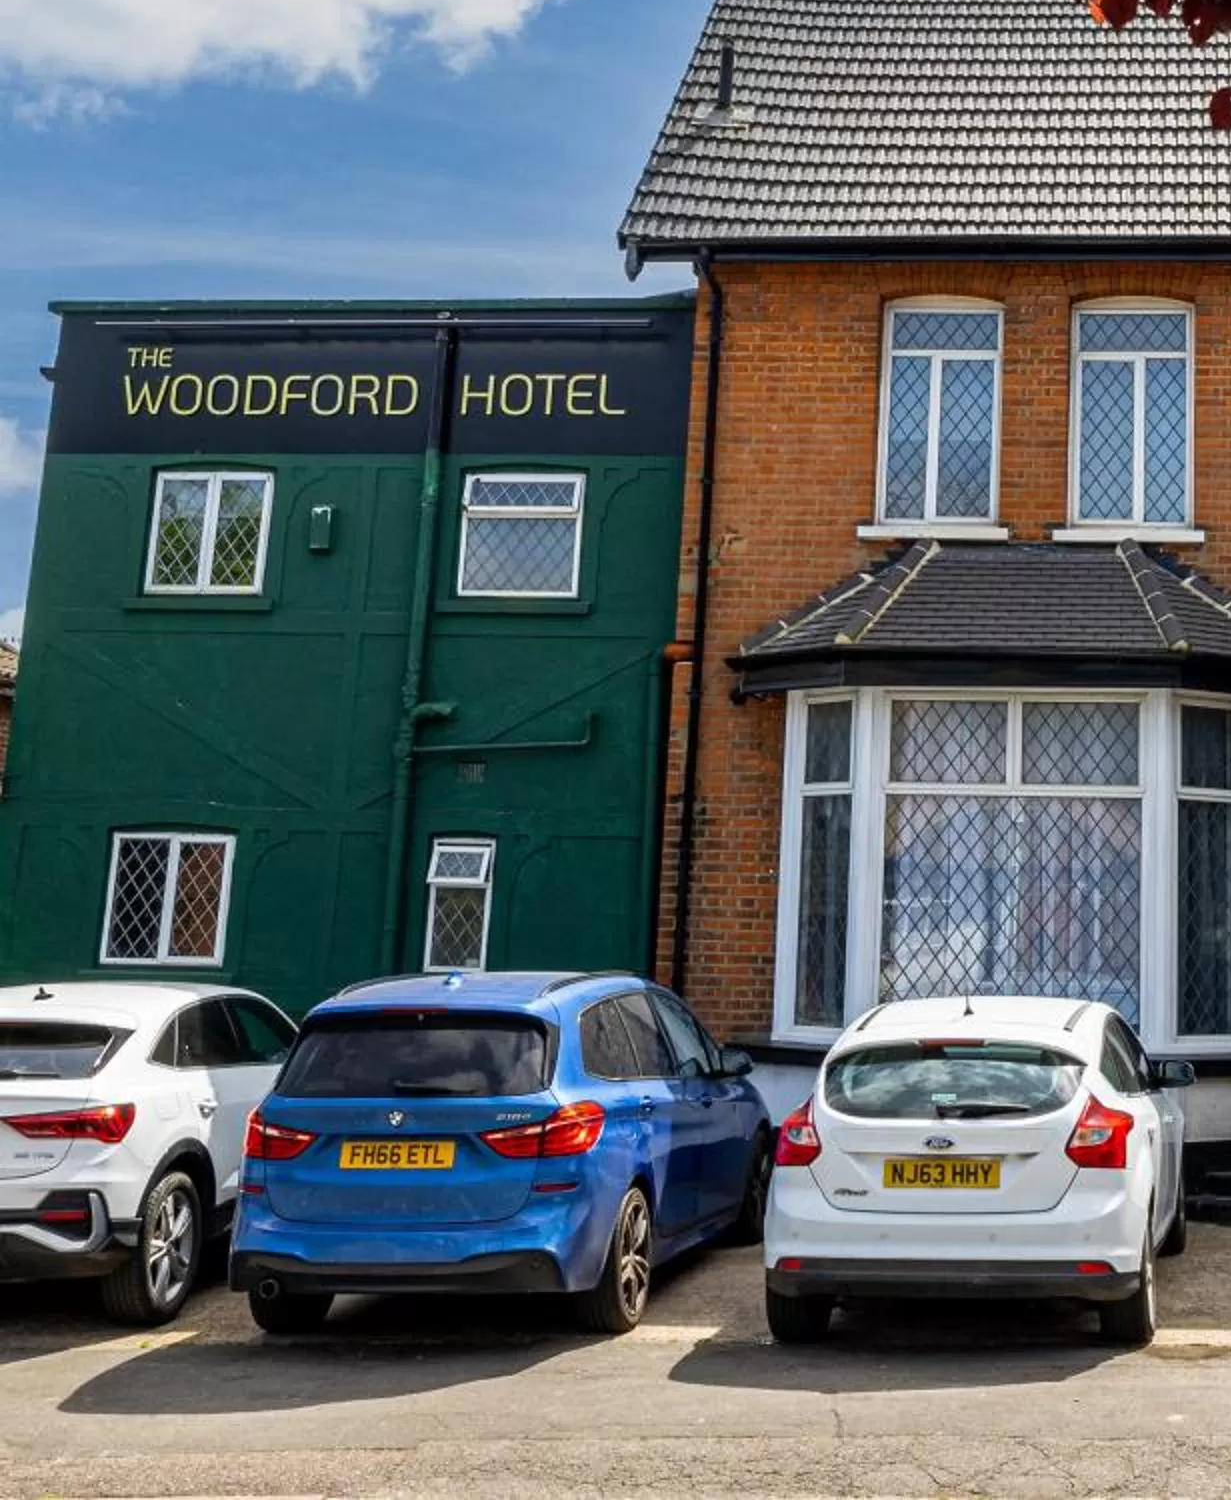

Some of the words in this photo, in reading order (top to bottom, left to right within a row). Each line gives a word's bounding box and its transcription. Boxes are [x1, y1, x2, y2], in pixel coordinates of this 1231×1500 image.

[127, 347, 175, 368] THE
[122, 373, 420, 417] WOODFORD
[460, 373, 627, 417] HOTEL
[349, 1143, 402, 1165] FH66
[406, 1143, 445, 1165] ETL
[891, 1162, 946, 1185] NJ63
[951, 1162, 993, 1185] HHY
